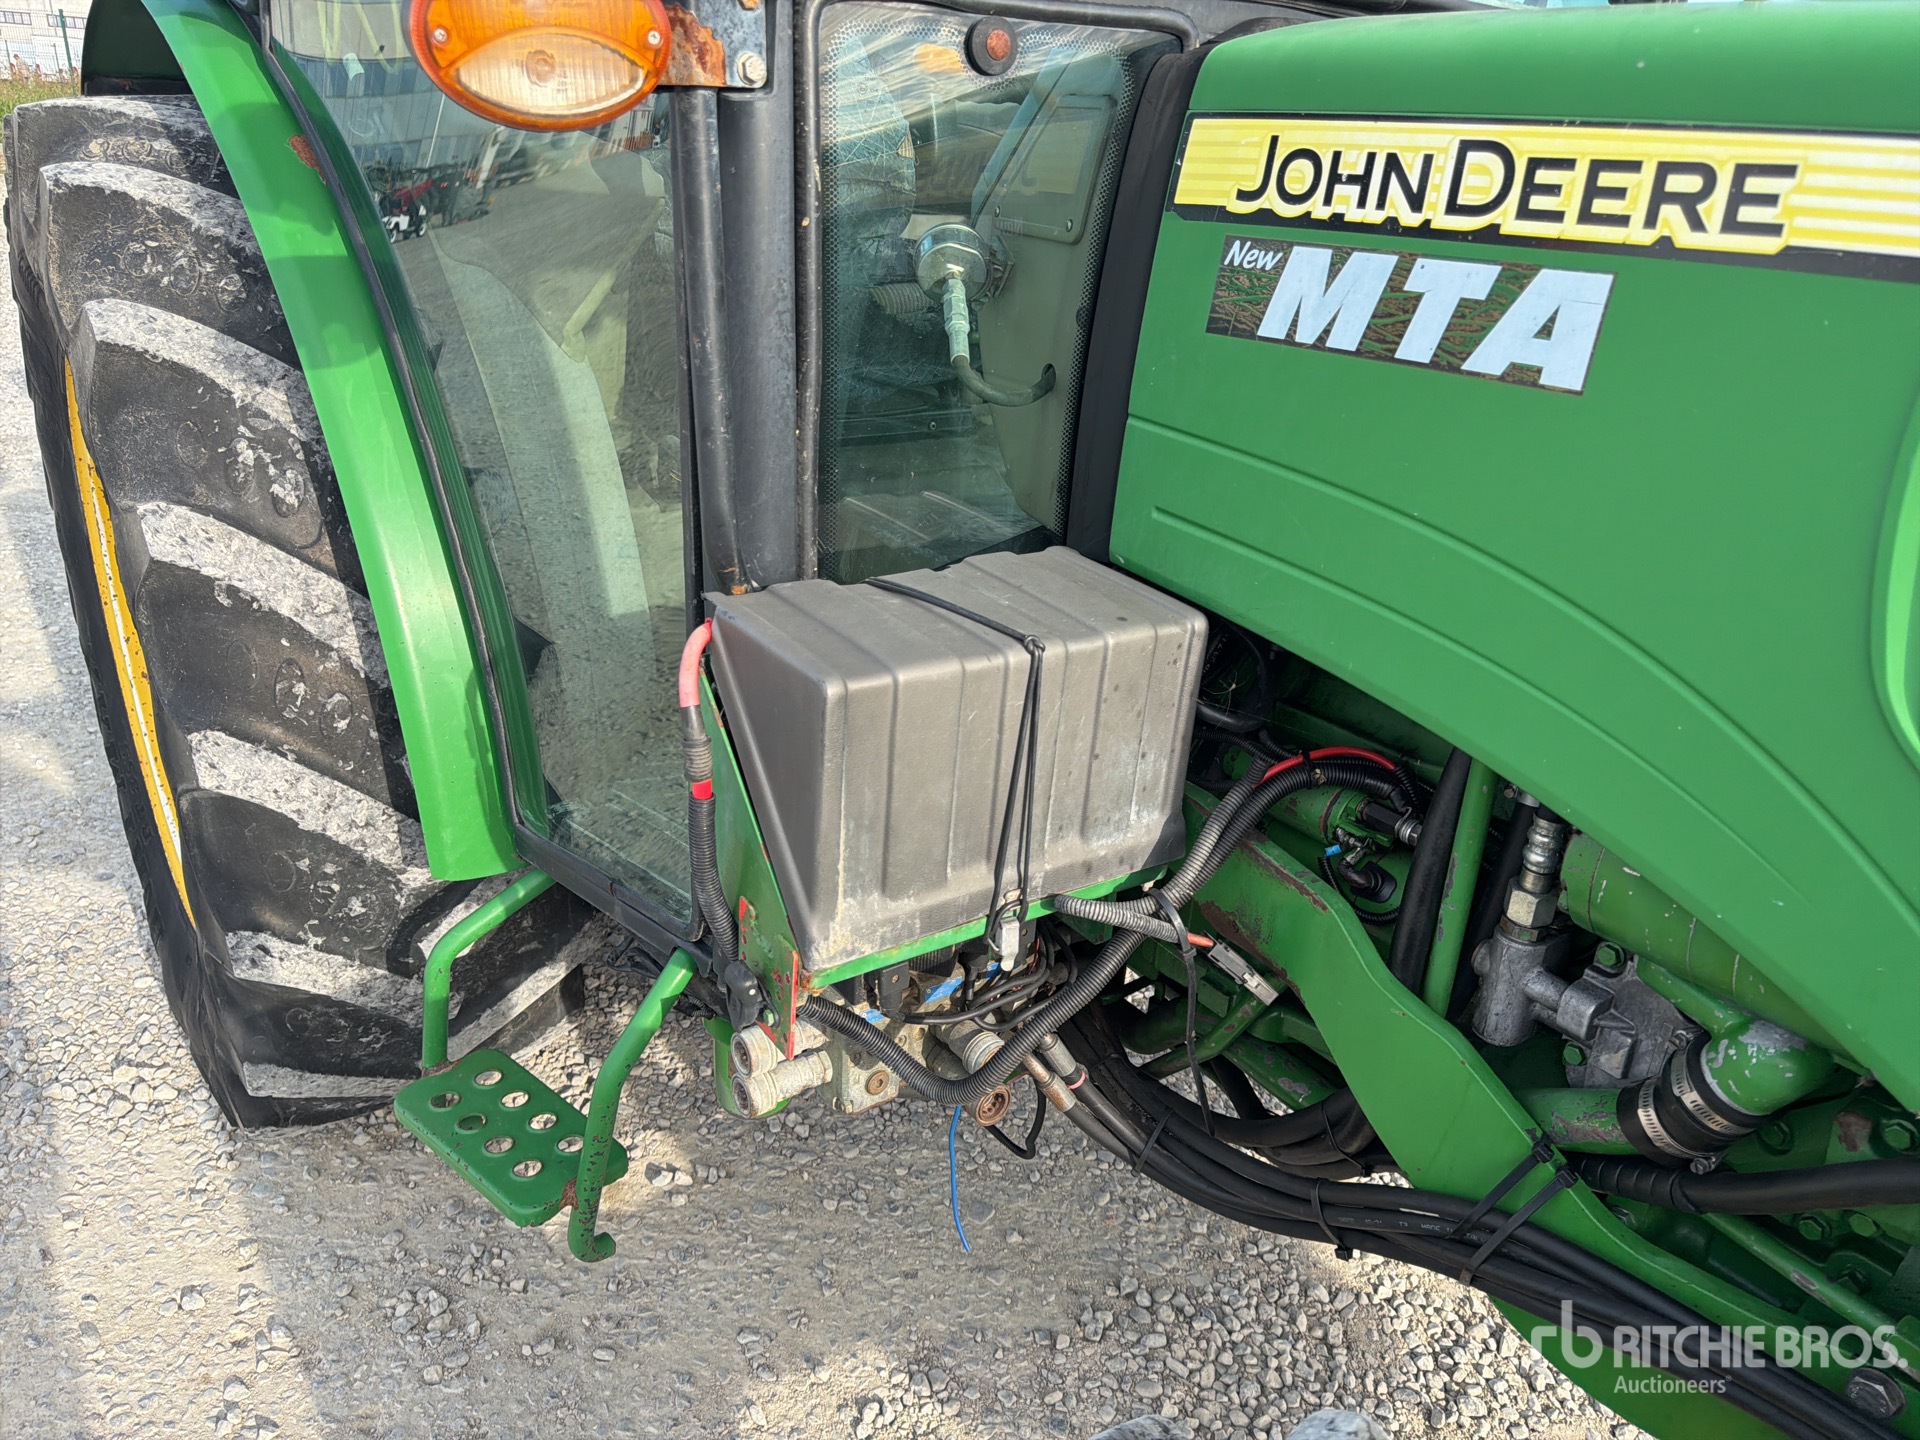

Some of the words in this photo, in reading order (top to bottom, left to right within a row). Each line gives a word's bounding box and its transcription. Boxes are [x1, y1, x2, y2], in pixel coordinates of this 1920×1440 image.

[1236, 135, 1435, 215] JOHN
[1444, 138, 1799, 238] DEERE
[1223, 240, 1283, 271] New
[1257, 245, 1614, 391] MTA
